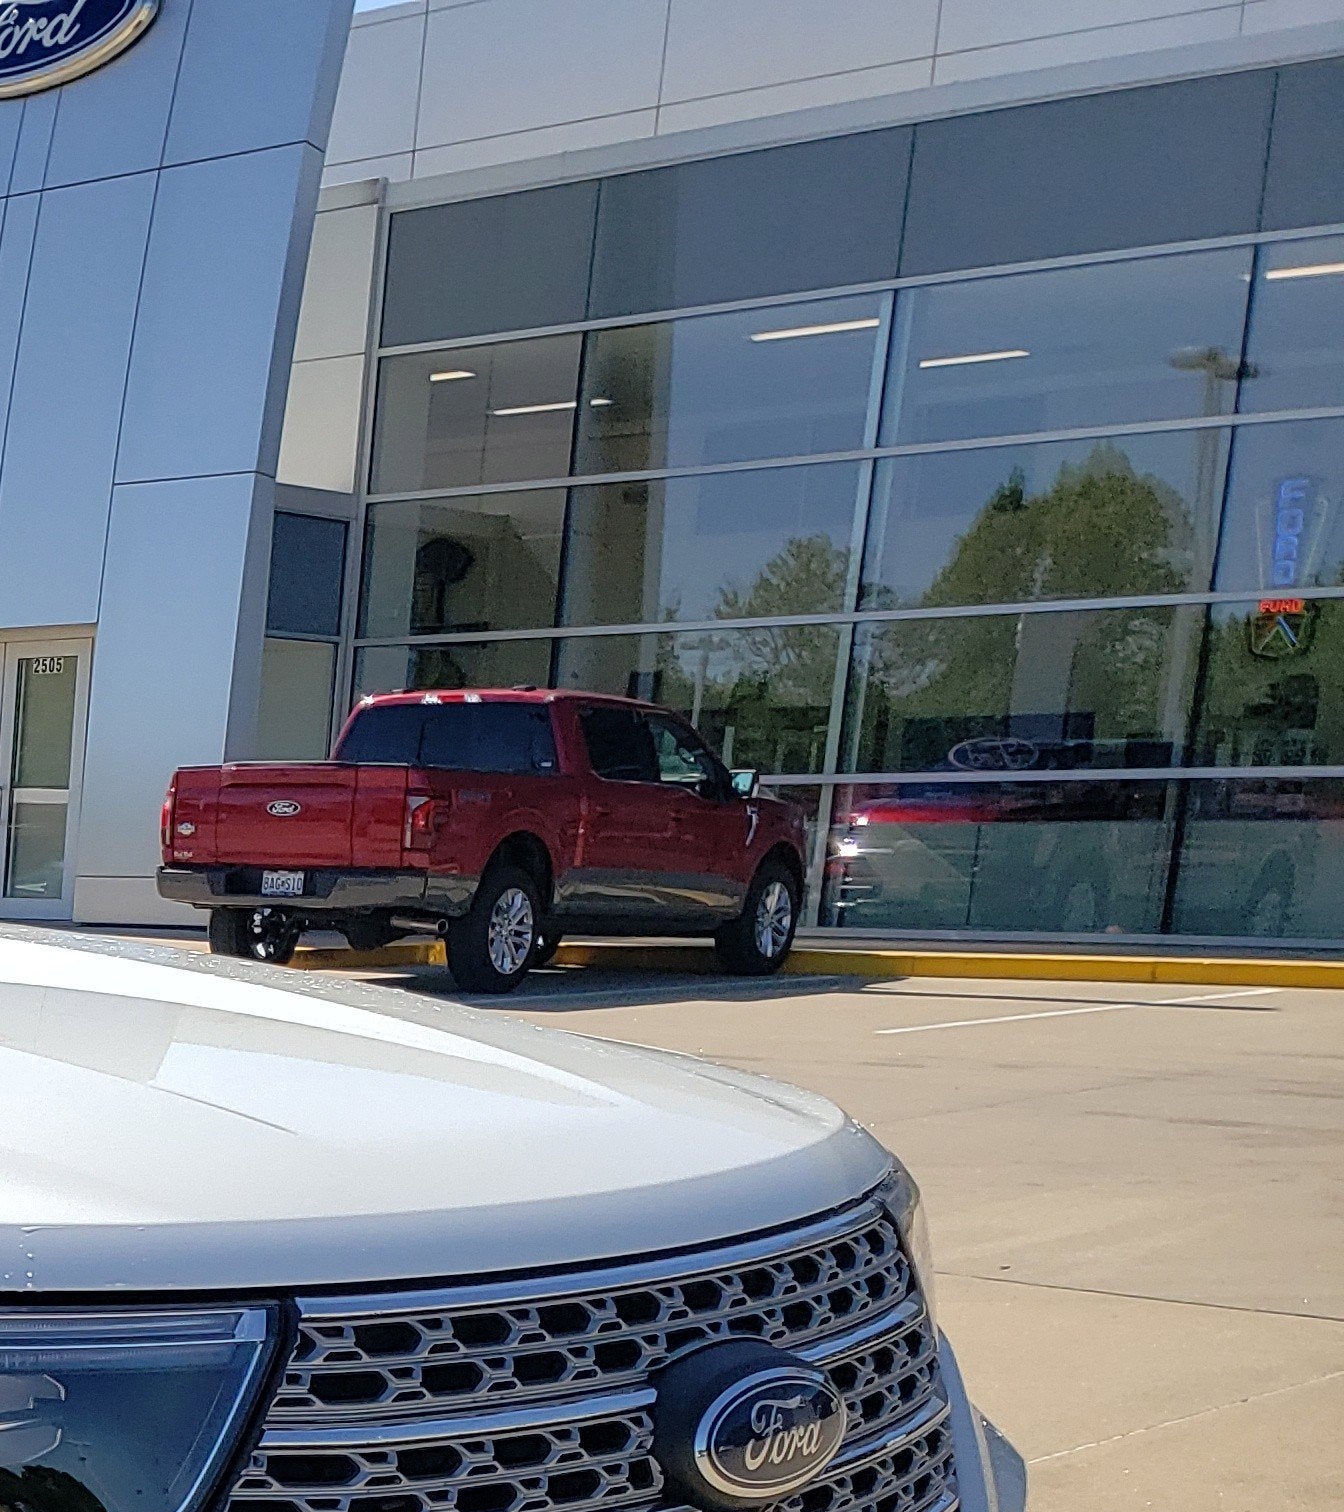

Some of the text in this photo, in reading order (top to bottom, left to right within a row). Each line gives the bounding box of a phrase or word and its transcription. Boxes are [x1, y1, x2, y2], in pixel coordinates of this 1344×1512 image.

[1271, 478, 1310, 586] FORD
[33, 657, 63, 674] 2505
[744, 1394, 823, 1471] Ford
